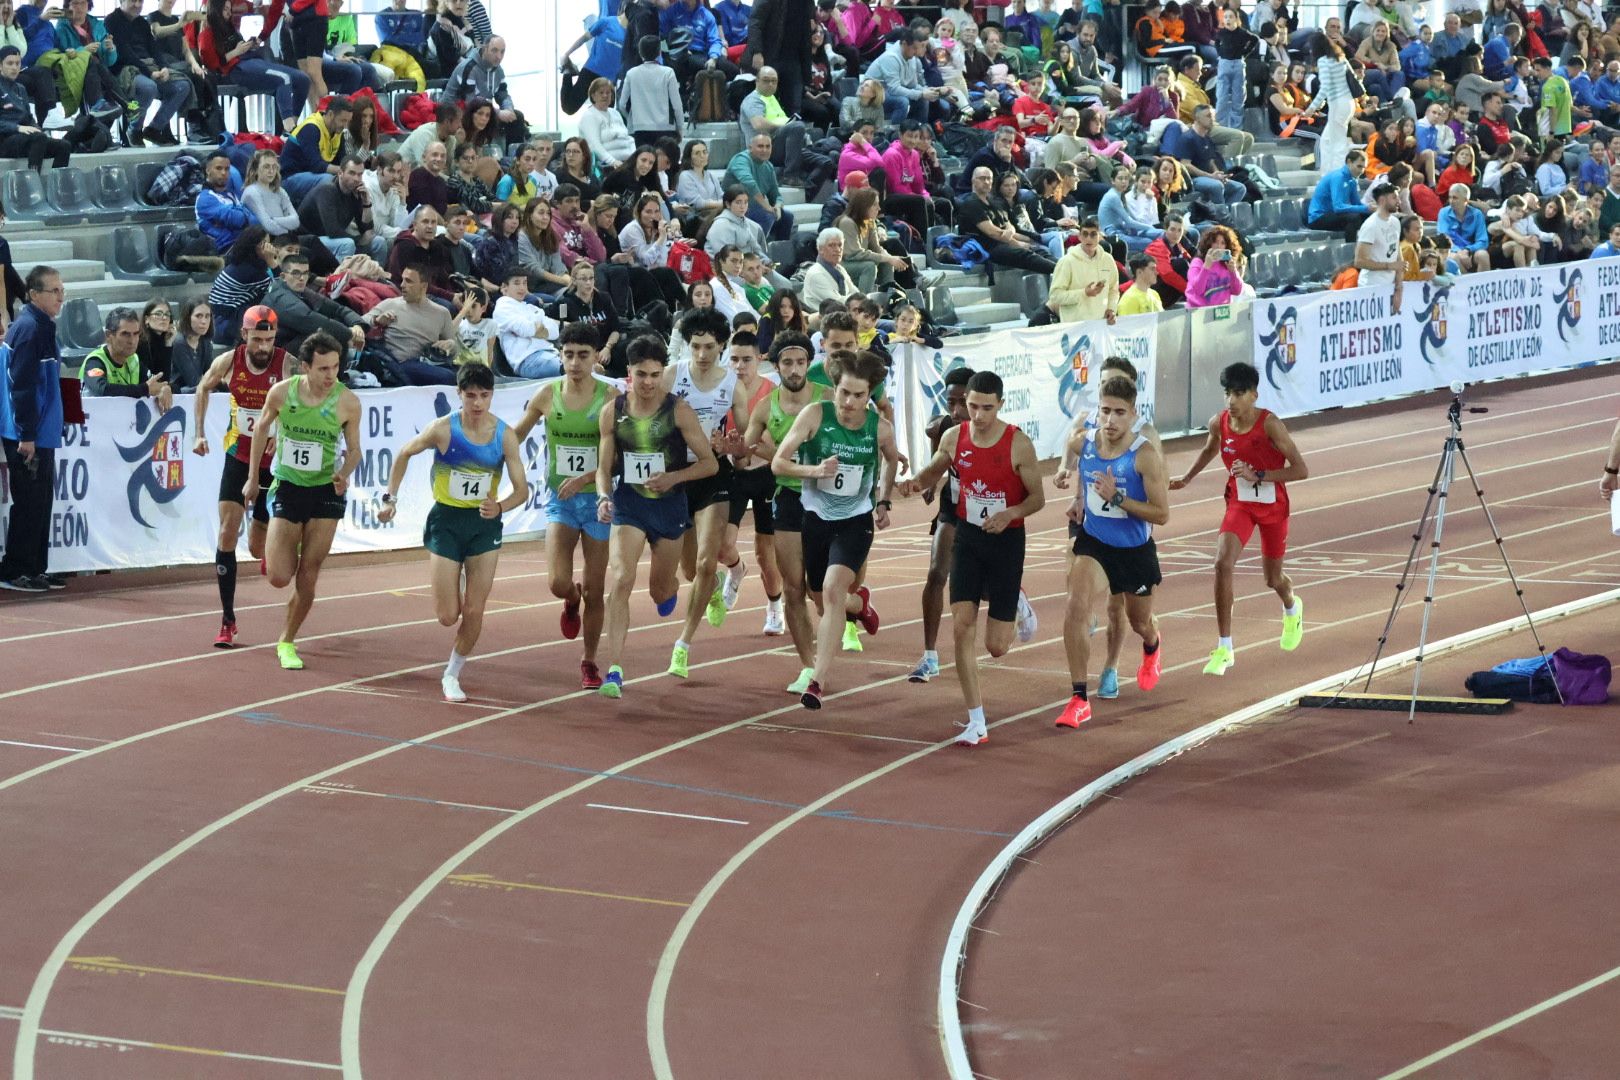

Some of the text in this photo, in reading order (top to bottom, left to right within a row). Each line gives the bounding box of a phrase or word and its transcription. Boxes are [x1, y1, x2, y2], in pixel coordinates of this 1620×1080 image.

[1467, 274, 1543, 307] FEDERACIÓN DE
[1320, 293, 1384, 328] FEDERACIÓN
[1467, 304, 1542, 339] ATLETISMO
[1320, 323, 1402, 363] ATLETISMO
[1599, 325, 1608, 345] DE
[1468, 333, 1543, 368] DE CASTILLA Y LEÓN
[1320, 353, 1402, 394] DE CASTILLA Y LEÓN
[369, 405, 393, 438] DE
[292, 449, 310, 466] 15
[831, 442, 874, 454] universidad
[567, 455, 585, 472] 12
[636, 462, 651, 479] 11
[461, 481, 480, 496] 14
[834, 473, 845, 490] 6
[980, 506, 988, 519] 4
[48, 505, 90, 547] EÓN
